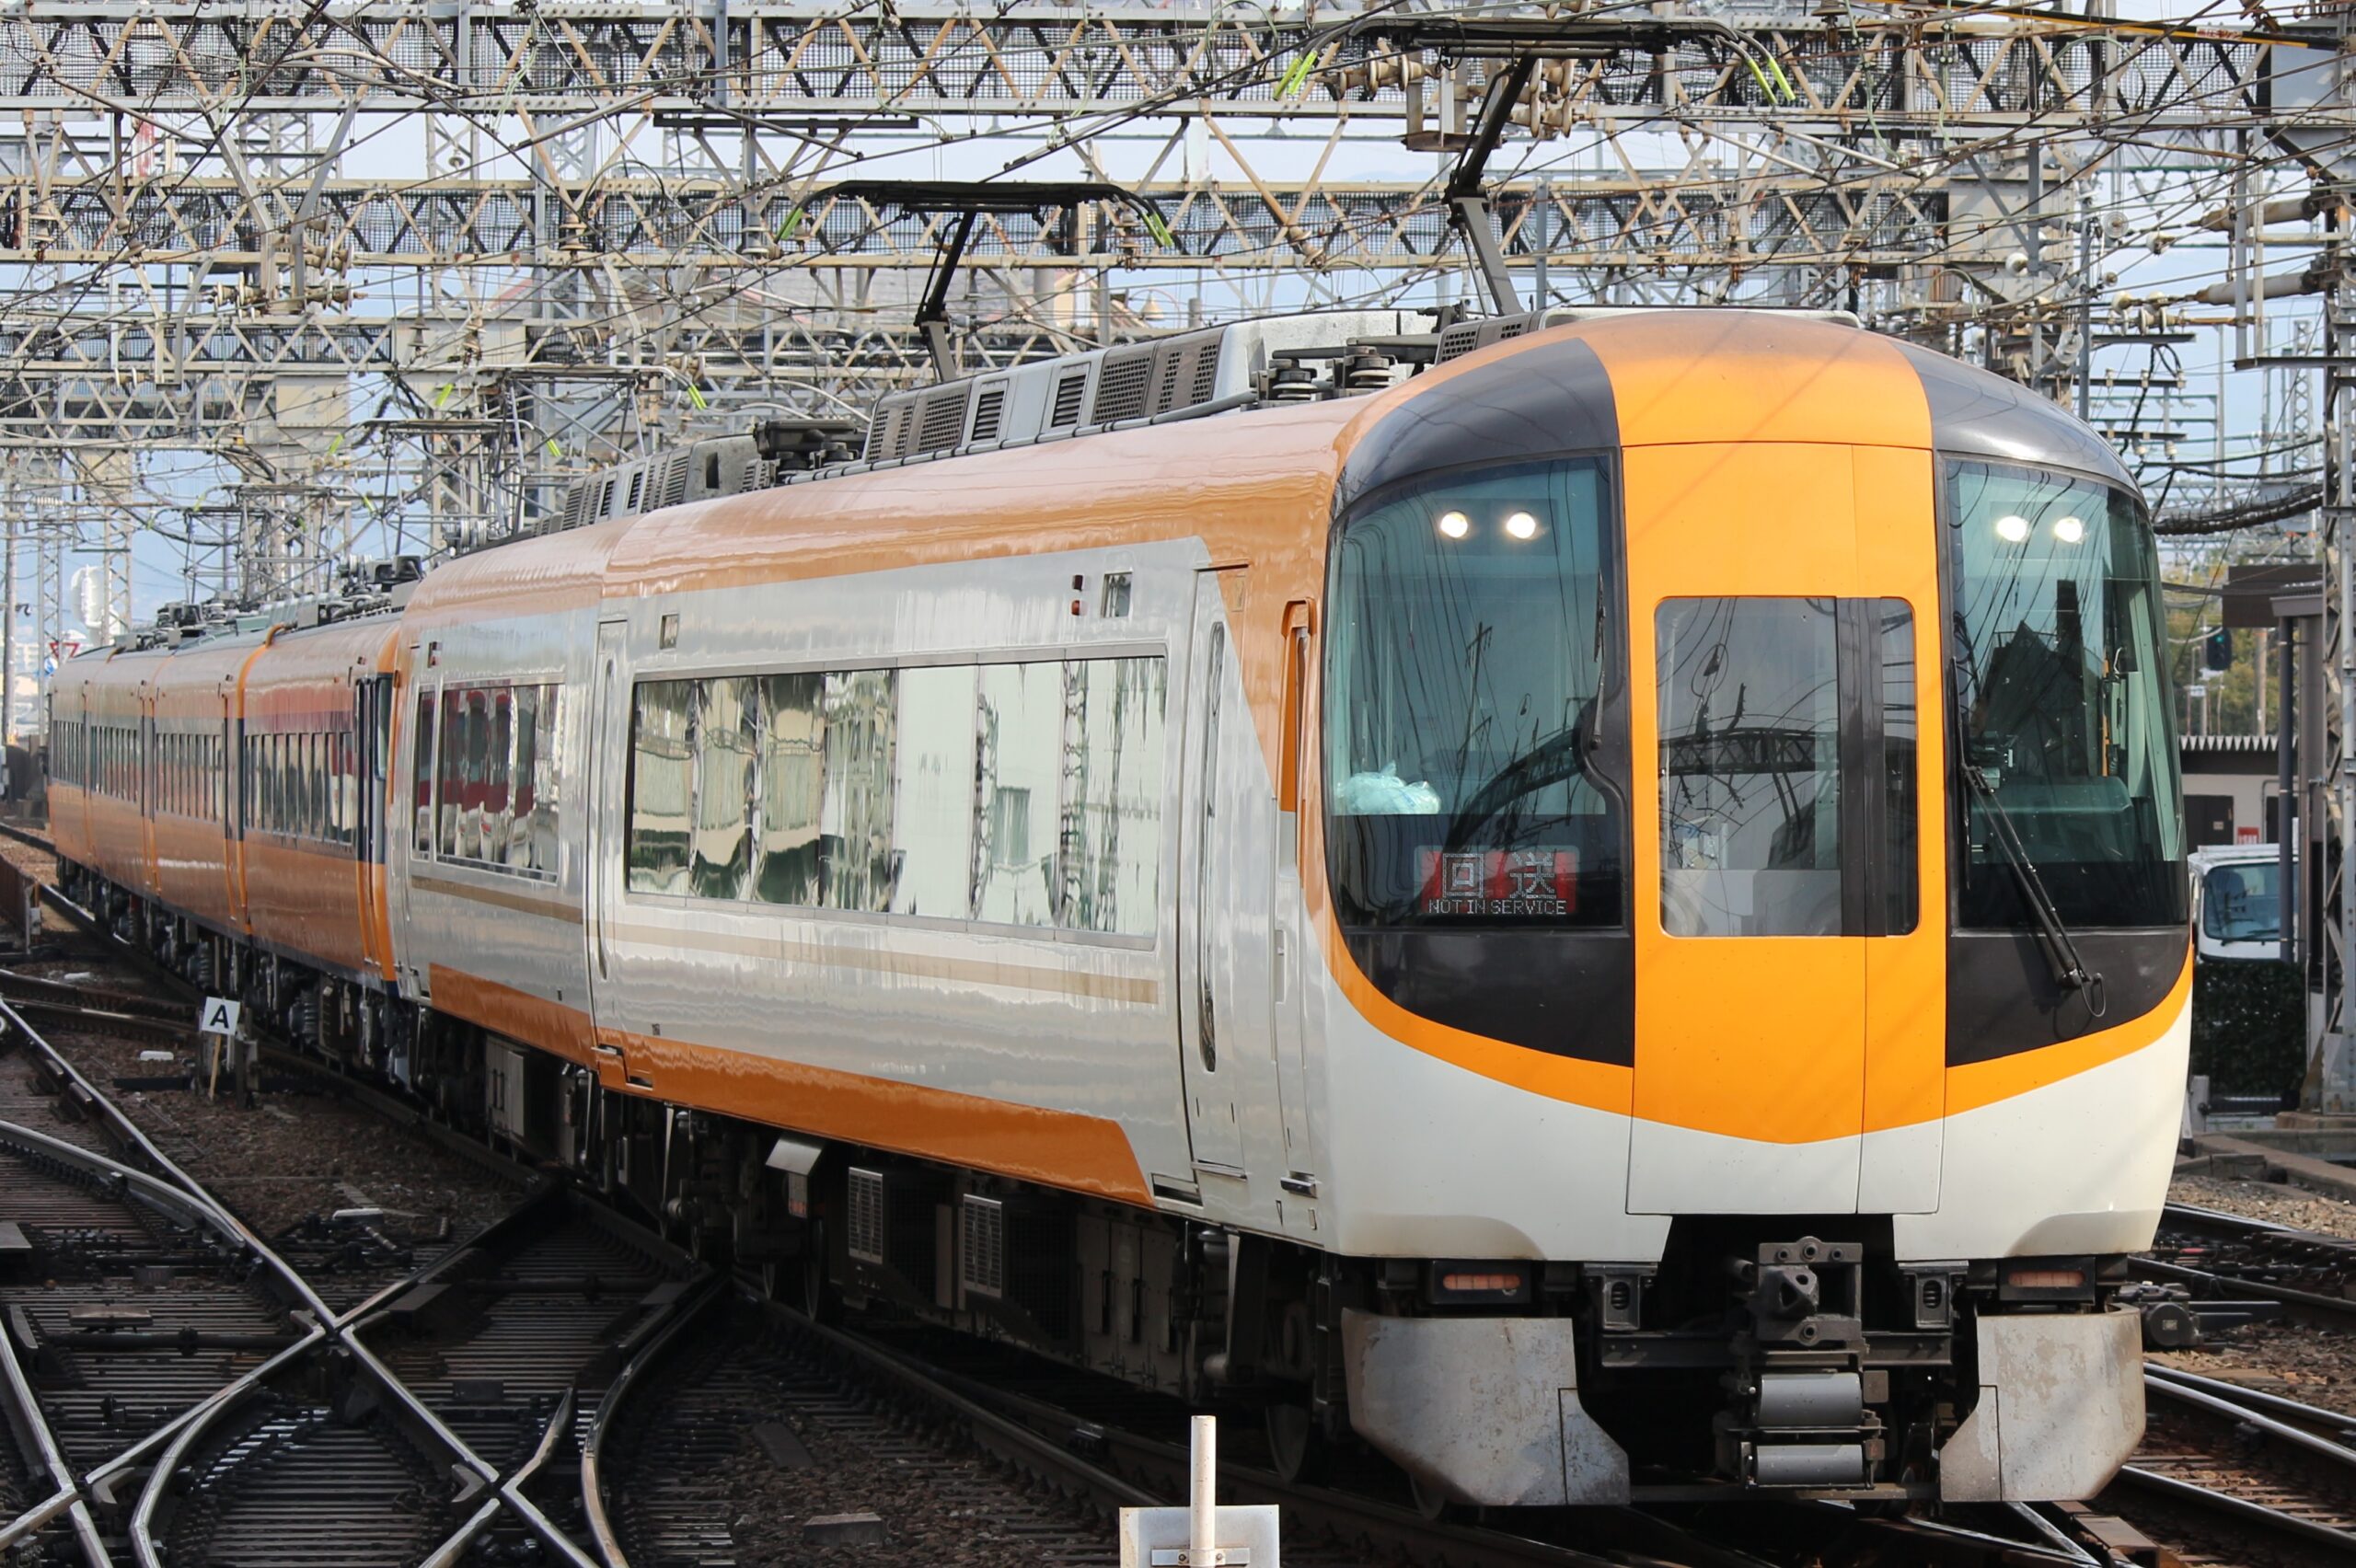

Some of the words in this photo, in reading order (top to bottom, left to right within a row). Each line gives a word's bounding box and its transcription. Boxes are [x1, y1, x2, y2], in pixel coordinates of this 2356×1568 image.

[1442, 852, 1557, 899] 回送
[1428, 899, 1461, 915] NOT
[1466, 900, 1485, 915] IN
[1490, 899, 1567, 915] SERVICE
[210, 1004, 229, 1029] A
